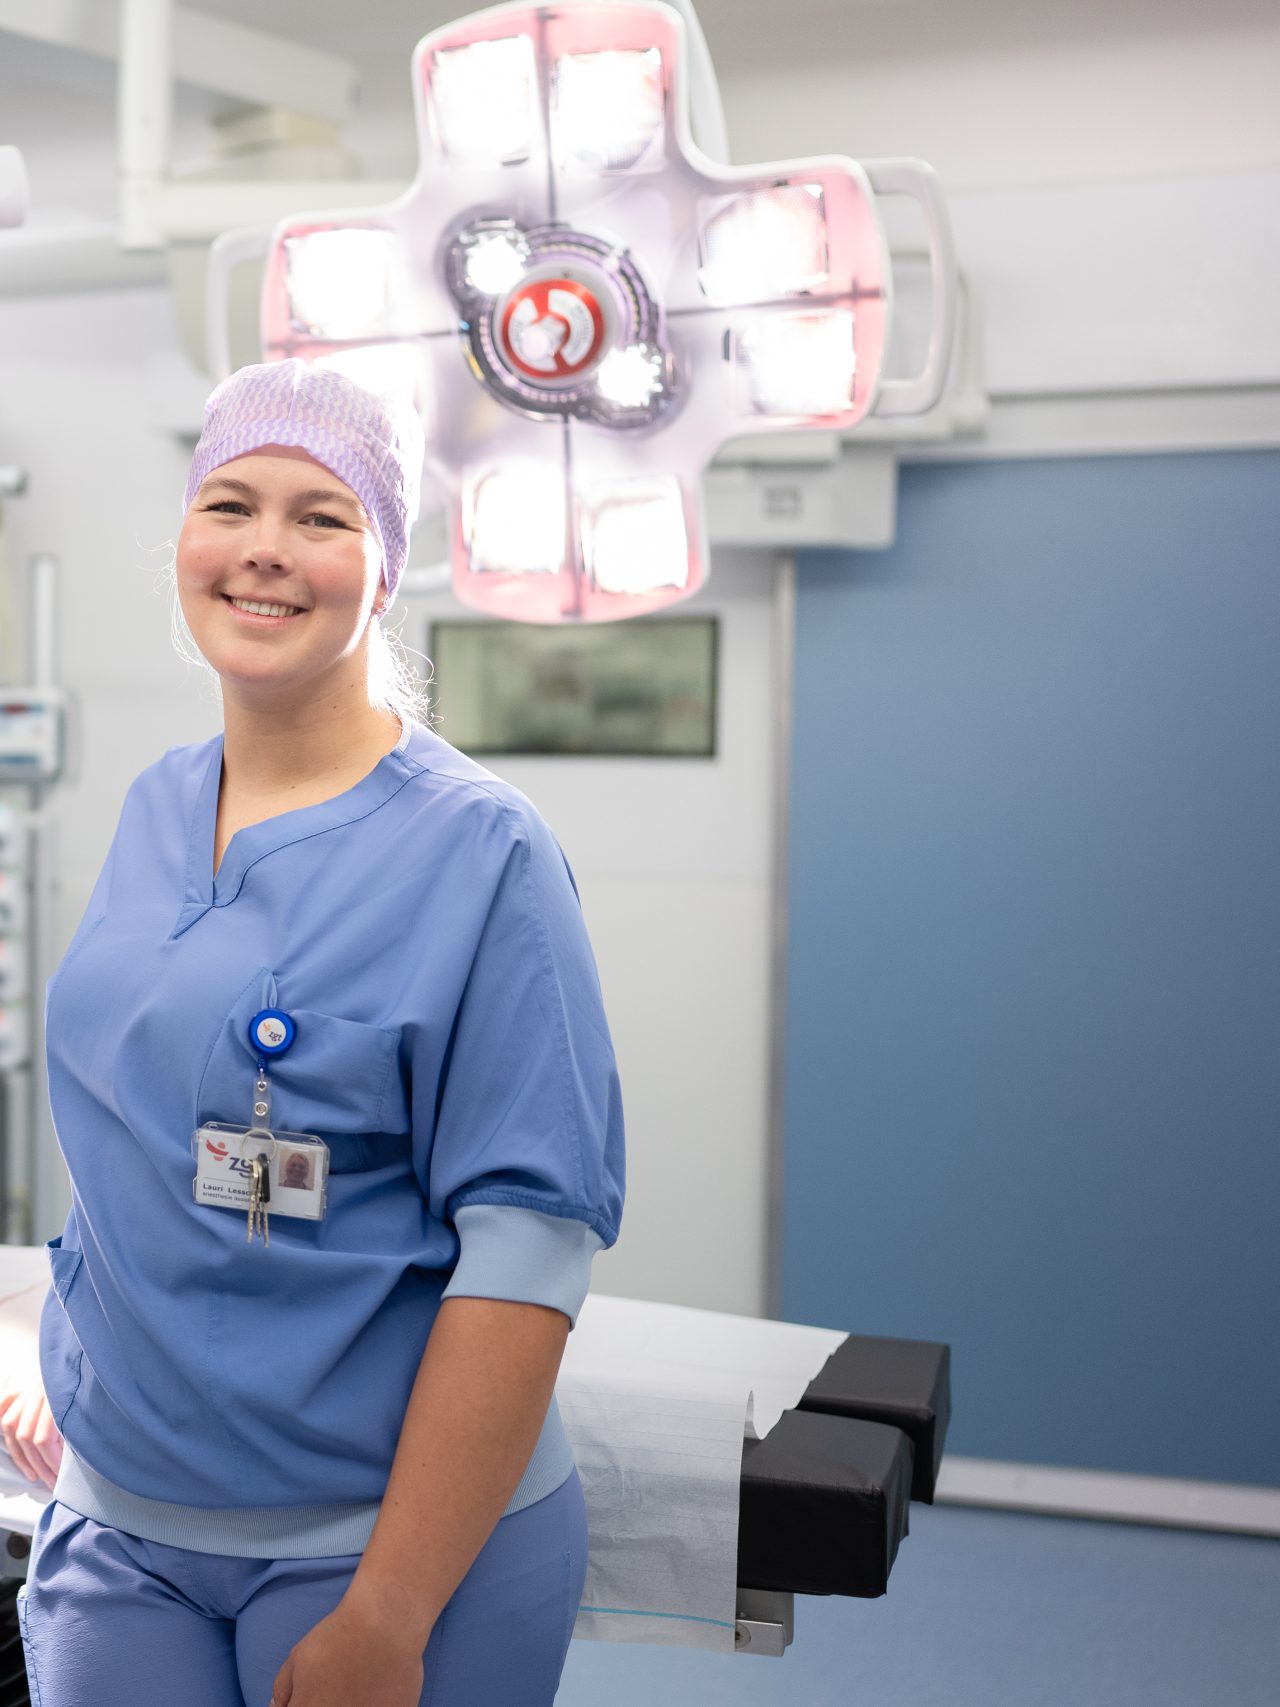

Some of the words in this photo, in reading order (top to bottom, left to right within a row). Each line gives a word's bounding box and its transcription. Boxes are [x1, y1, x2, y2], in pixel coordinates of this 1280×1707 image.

[268, 1031, 282, 1042] zgt
[228, 1156, 251, 1178] zg
[203, 1183, 223, 1192] Lauri
